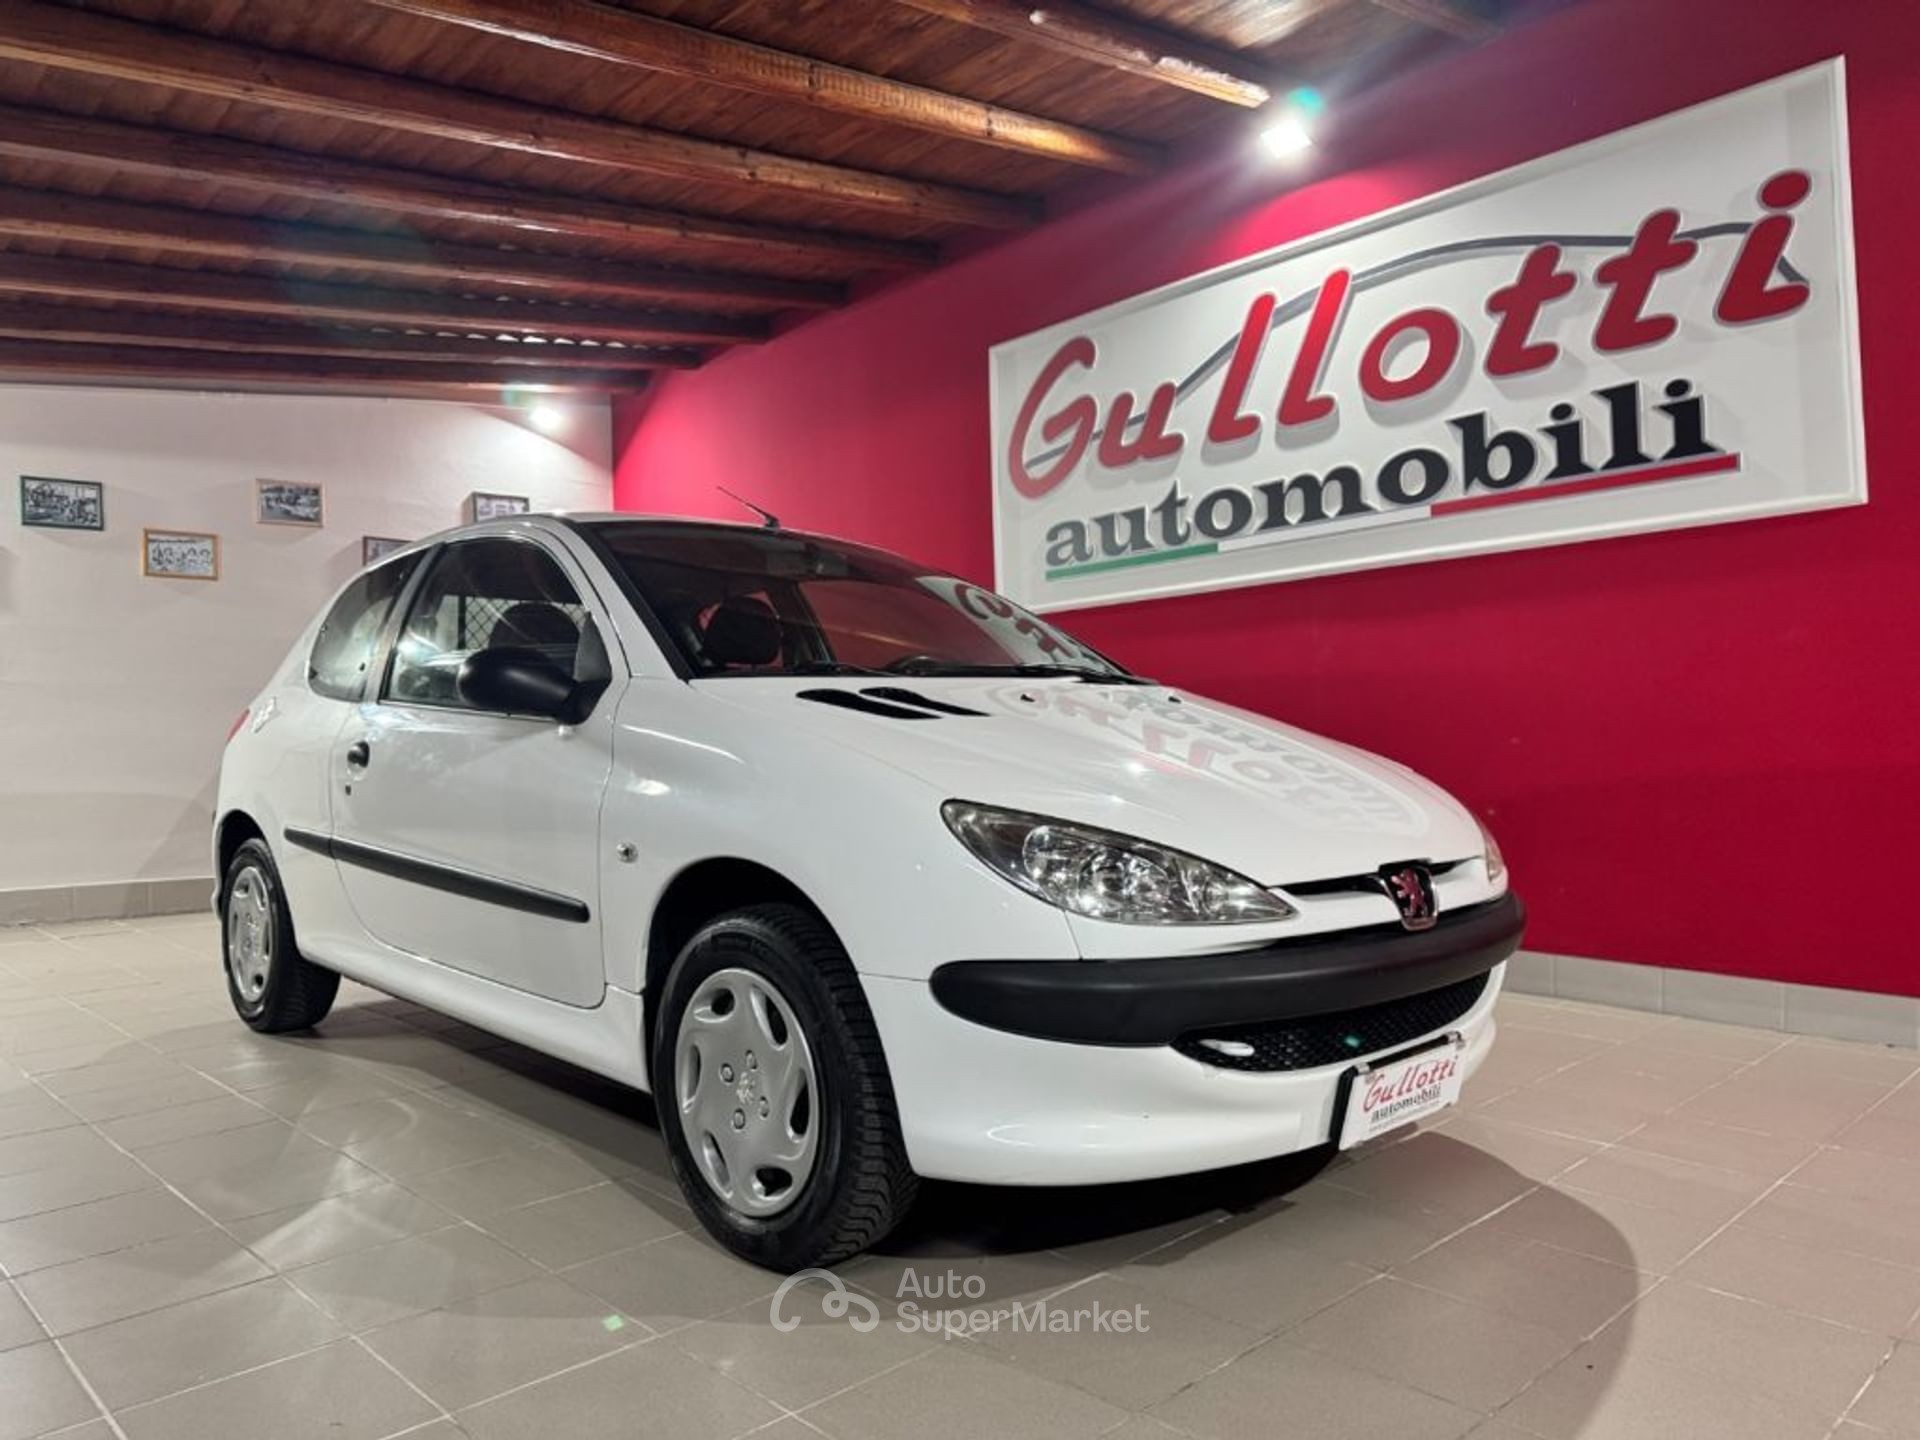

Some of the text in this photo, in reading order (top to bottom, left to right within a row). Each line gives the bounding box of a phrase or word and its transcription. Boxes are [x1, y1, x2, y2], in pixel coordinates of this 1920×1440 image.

[1008, 169, 1813, 500] Gullotti
[1045, 378, 1716, 567] automobili
[1362, 1055, 1459, 1112] Gullotti
[1371, 1084, 1442, 1122] automobili
